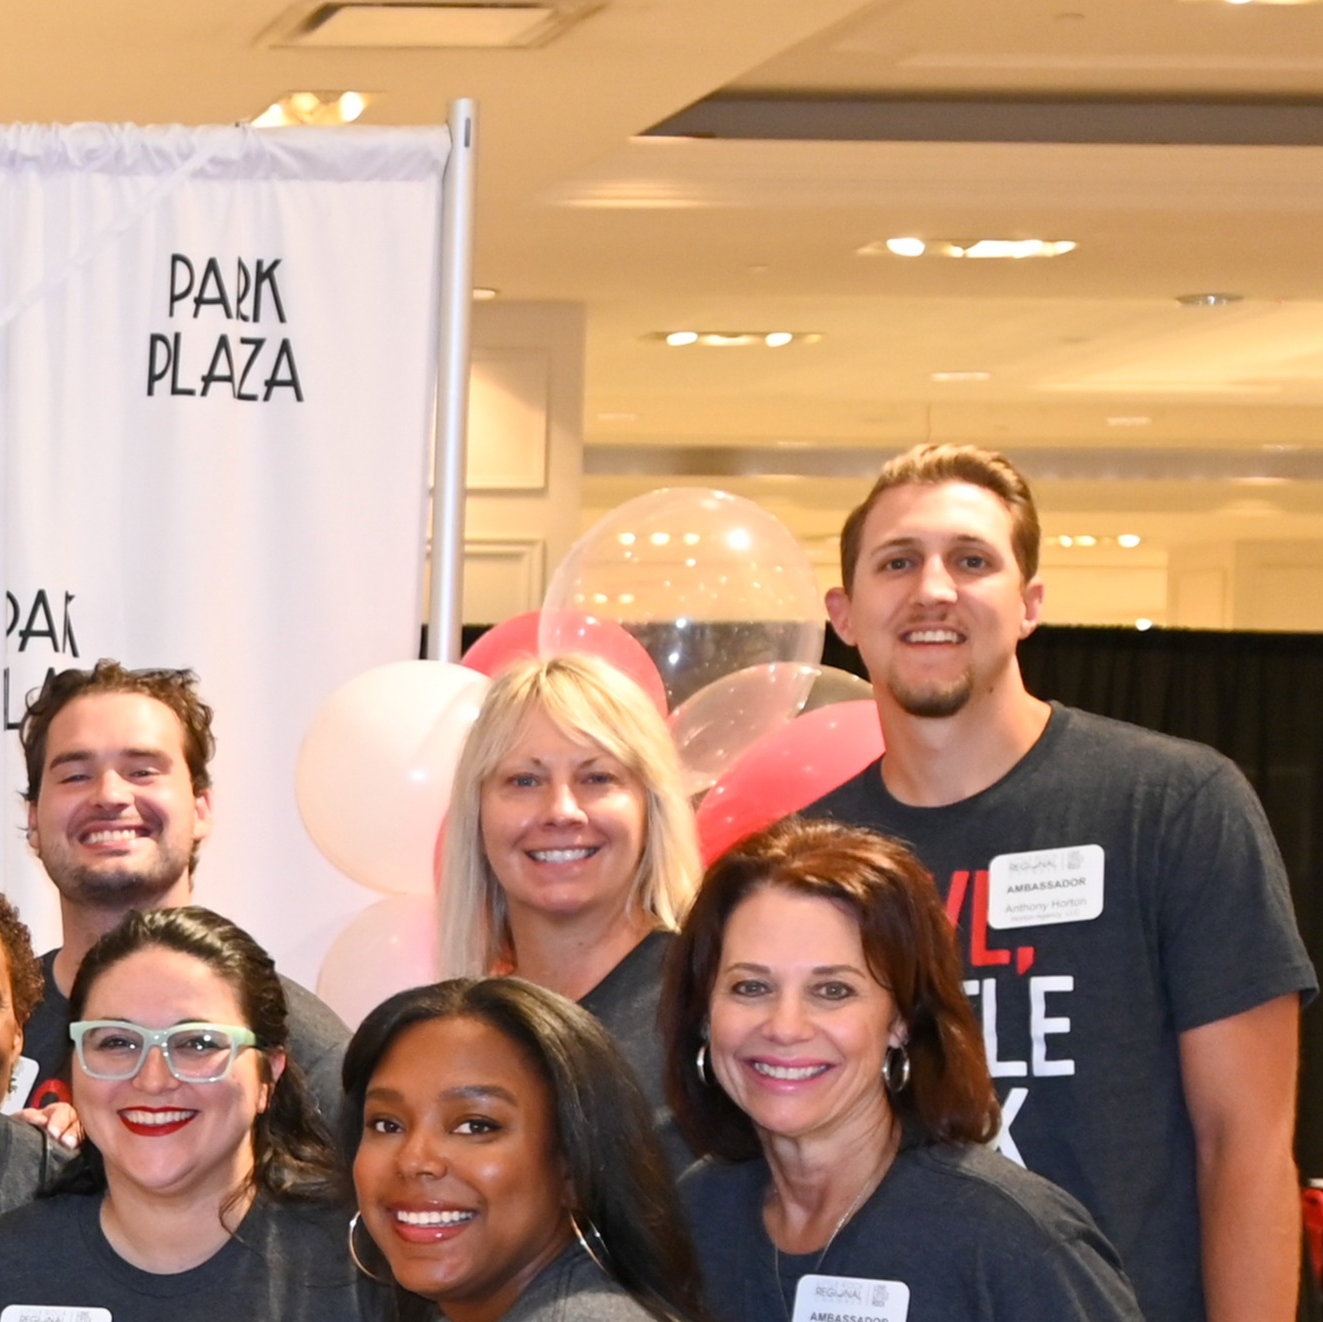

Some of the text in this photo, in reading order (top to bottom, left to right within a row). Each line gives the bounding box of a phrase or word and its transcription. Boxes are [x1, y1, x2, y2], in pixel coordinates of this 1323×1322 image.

[169, 253, 286, 323] PARK
[148, 332, 303, 402] PLAZA
[1005, 898, 1087, 914] Anthony Horton
[1006, 877, 1087, 894] AMBASSADOR
